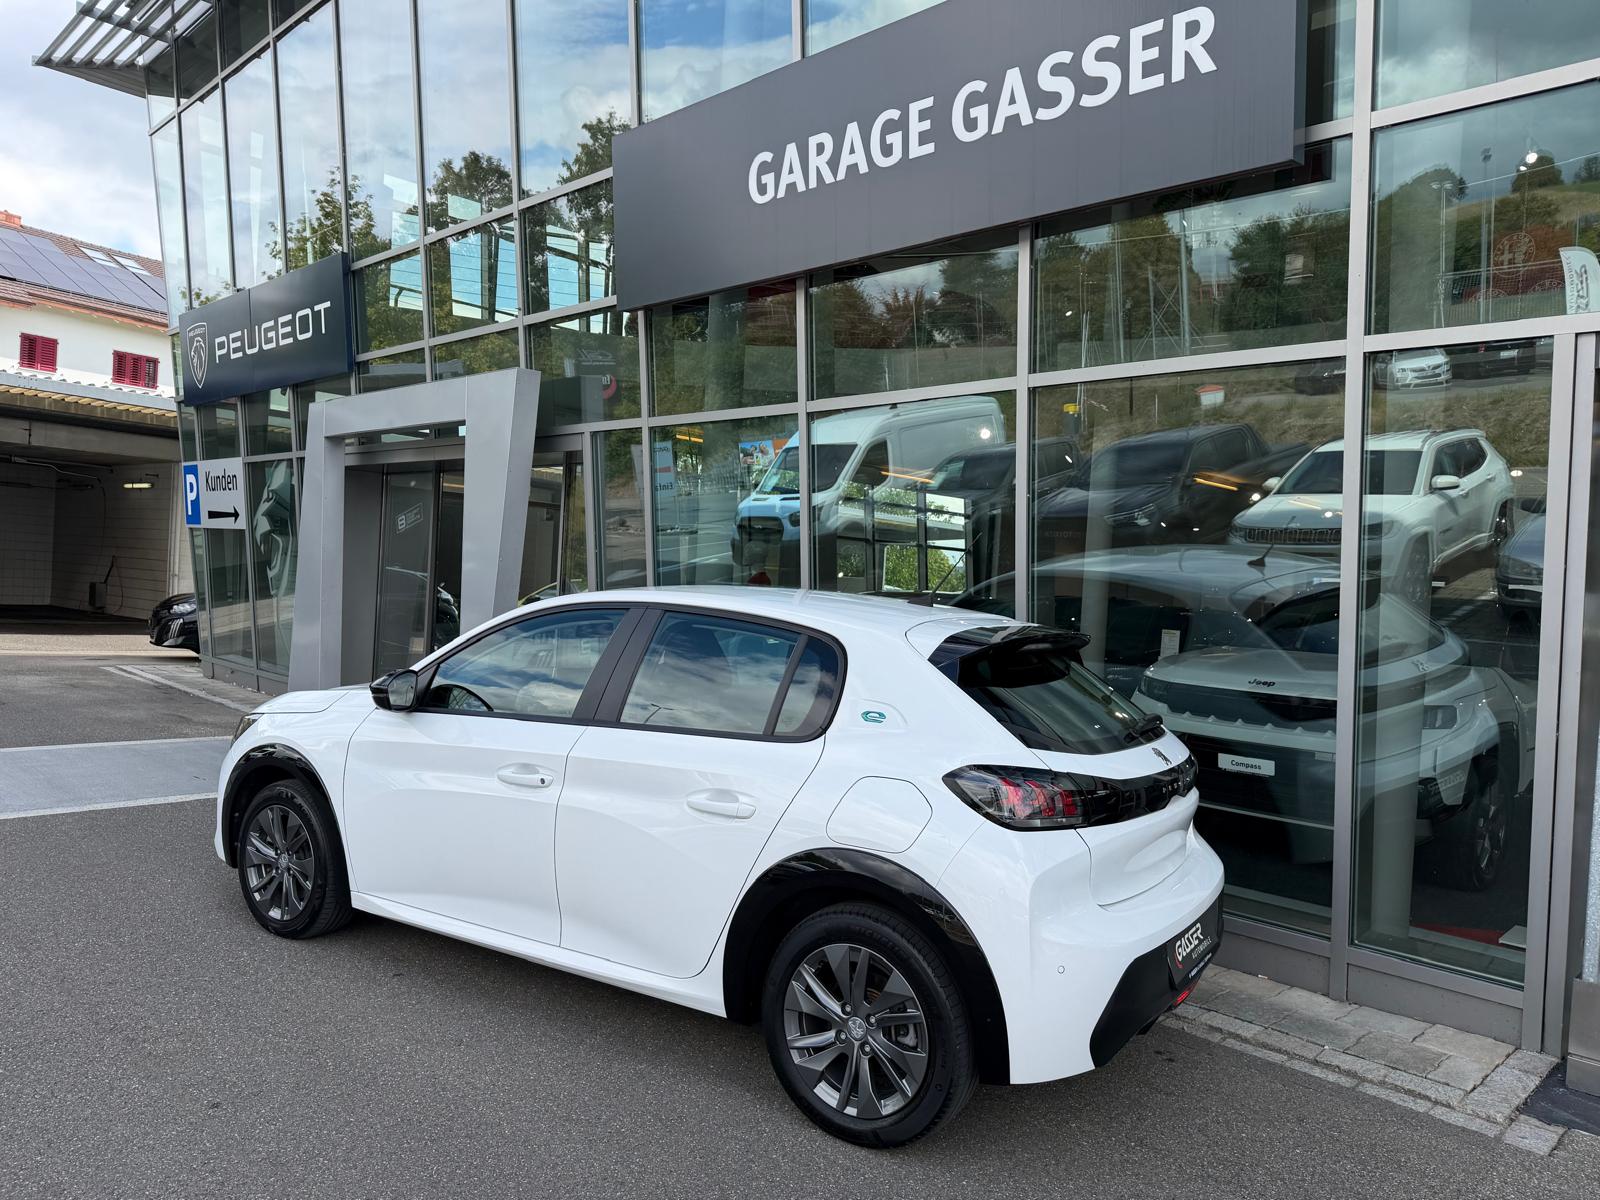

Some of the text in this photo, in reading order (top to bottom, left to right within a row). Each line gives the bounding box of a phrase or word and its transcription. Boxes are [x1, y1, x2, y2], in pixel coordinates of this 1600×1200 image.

[748, 5, 1219, 205] GARAGE GASSER
[214, 300, 332, 364] PEUGEOT
[185, 467, 238, 516] P Kunden
[1247, 678, 1276, 688] Jeep
[1230, 759, 1262, 771] Compass
[1175, 922, 1204, 962] GASSER
